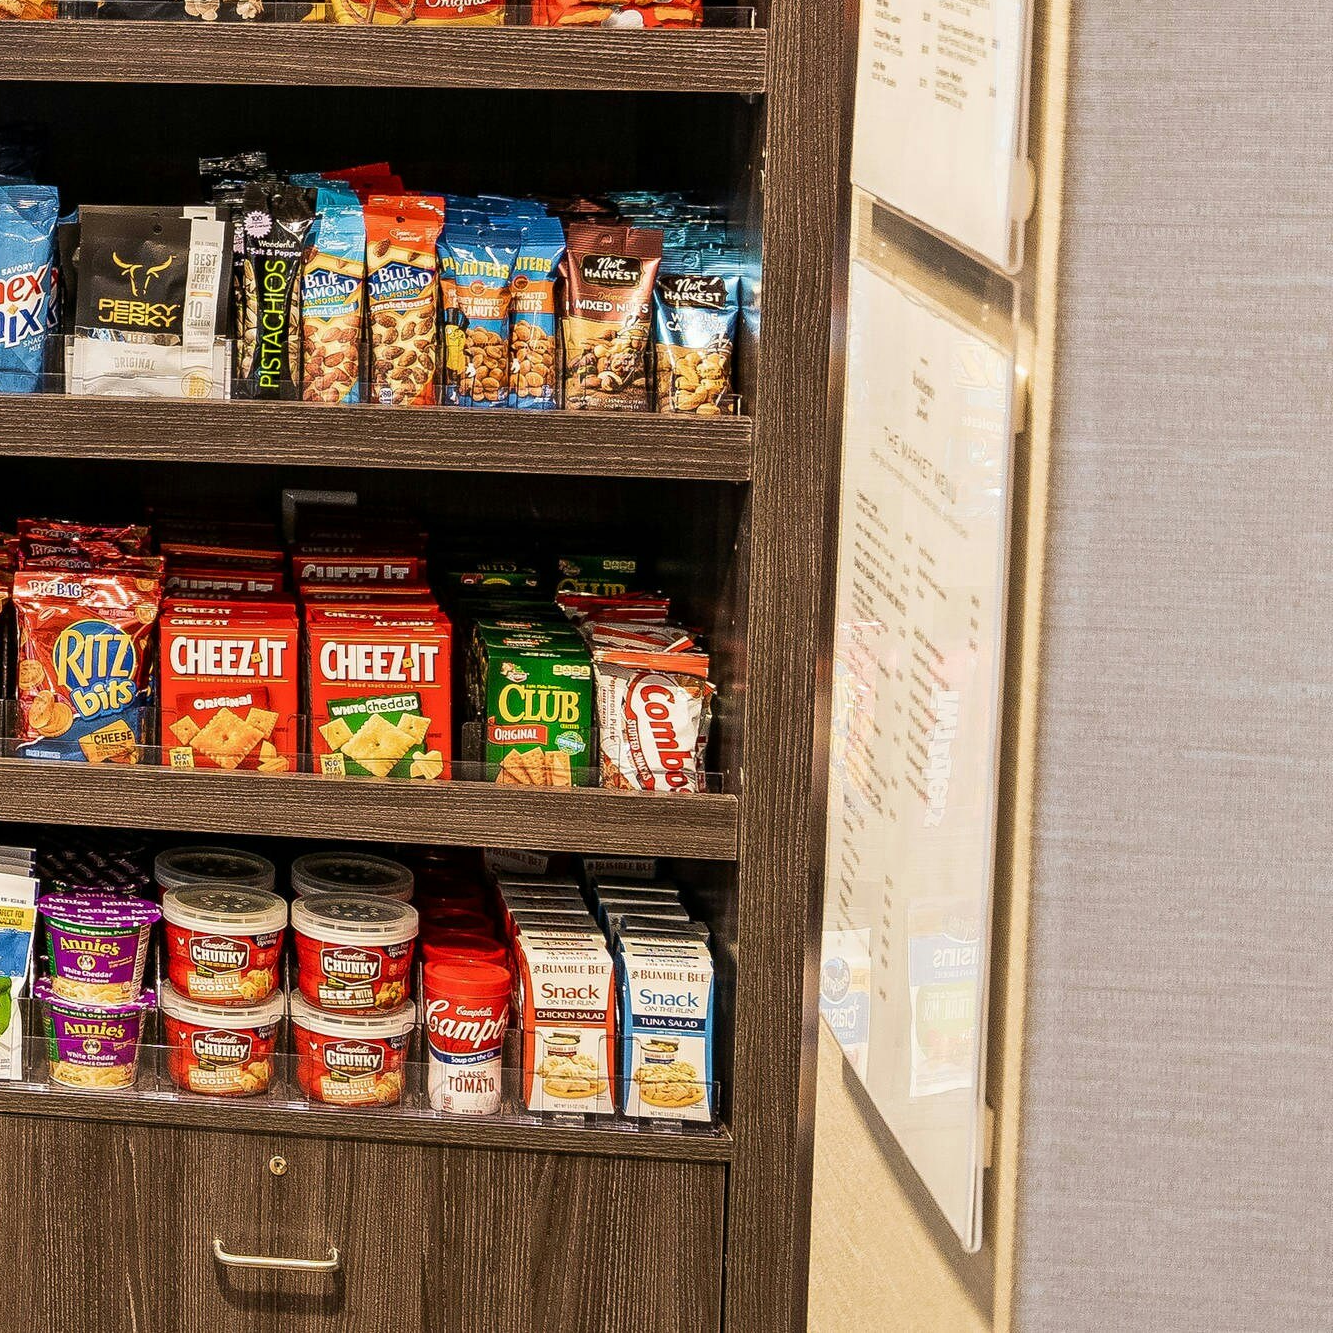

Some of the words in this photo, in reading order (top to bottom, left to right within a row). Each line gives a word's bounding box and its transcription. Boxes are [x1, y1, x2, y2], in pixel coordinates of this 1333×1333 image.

[250, 248, 265, 256] Salt
[194, 253, 217, 267] BEST
[597, 258, 625, 270] Nut
[1, 263, 33, 276] SAVORY
[378, 266, 412, 282] BLUE
[585, 270, 638, 281] HARVEST
[304, 271, 340, 288] BLUE
[665, 291, 721, 302] HARVEST
[99, 298, 177, 312] PERKY
[575, 300, 612, 312] MIXED
[99, 313, 177, 327] JERKY
[260, 260, 285, 387] PISTACHIOS
[58, 630, 131, 688] RITZ
[170, 637, 287, 676] CHEEZ-IT
[75, 681, 133, 716] bits
[367, 696, 418, 713] cheddar
[499, 684, 580, 722] CLUB
[94, 730, 132, 744] CHEESE
[495, 728, 537, 740] ORIGINAL
[60, 937, 120, 956] Annie's
[192, 946, 245, 964] CHUNKY
[323, 958, 379, 976] CHUNKY
[542, 964, 584, 974] BUMBLE
[587, 966, 607, 975] BEE
[641, 970, 683, 981] BUMBLE
[687, 973, 707, 983] BEE
[319, 990, 353, 1000] BEEF
[541, 984, 599, 999] Snack
[640, 989, 699, 1007] Snack
[560, 998, 573, 1006] THE
[537, 1010, 573, 1019] CHICKEN
[576, 1012, 605, 1020] SALAD
[64, 1021, 125, 1037] Annie's
[641, 1018, 665, 1026] TUNA
[668, 1019, 697, 1028] SALAD
[195, 1040, 248, 1057] CHUNKY
[326, 1051, 381, 1068] CHUNKY
[449, 1076, 495, 1092] TOMATO
